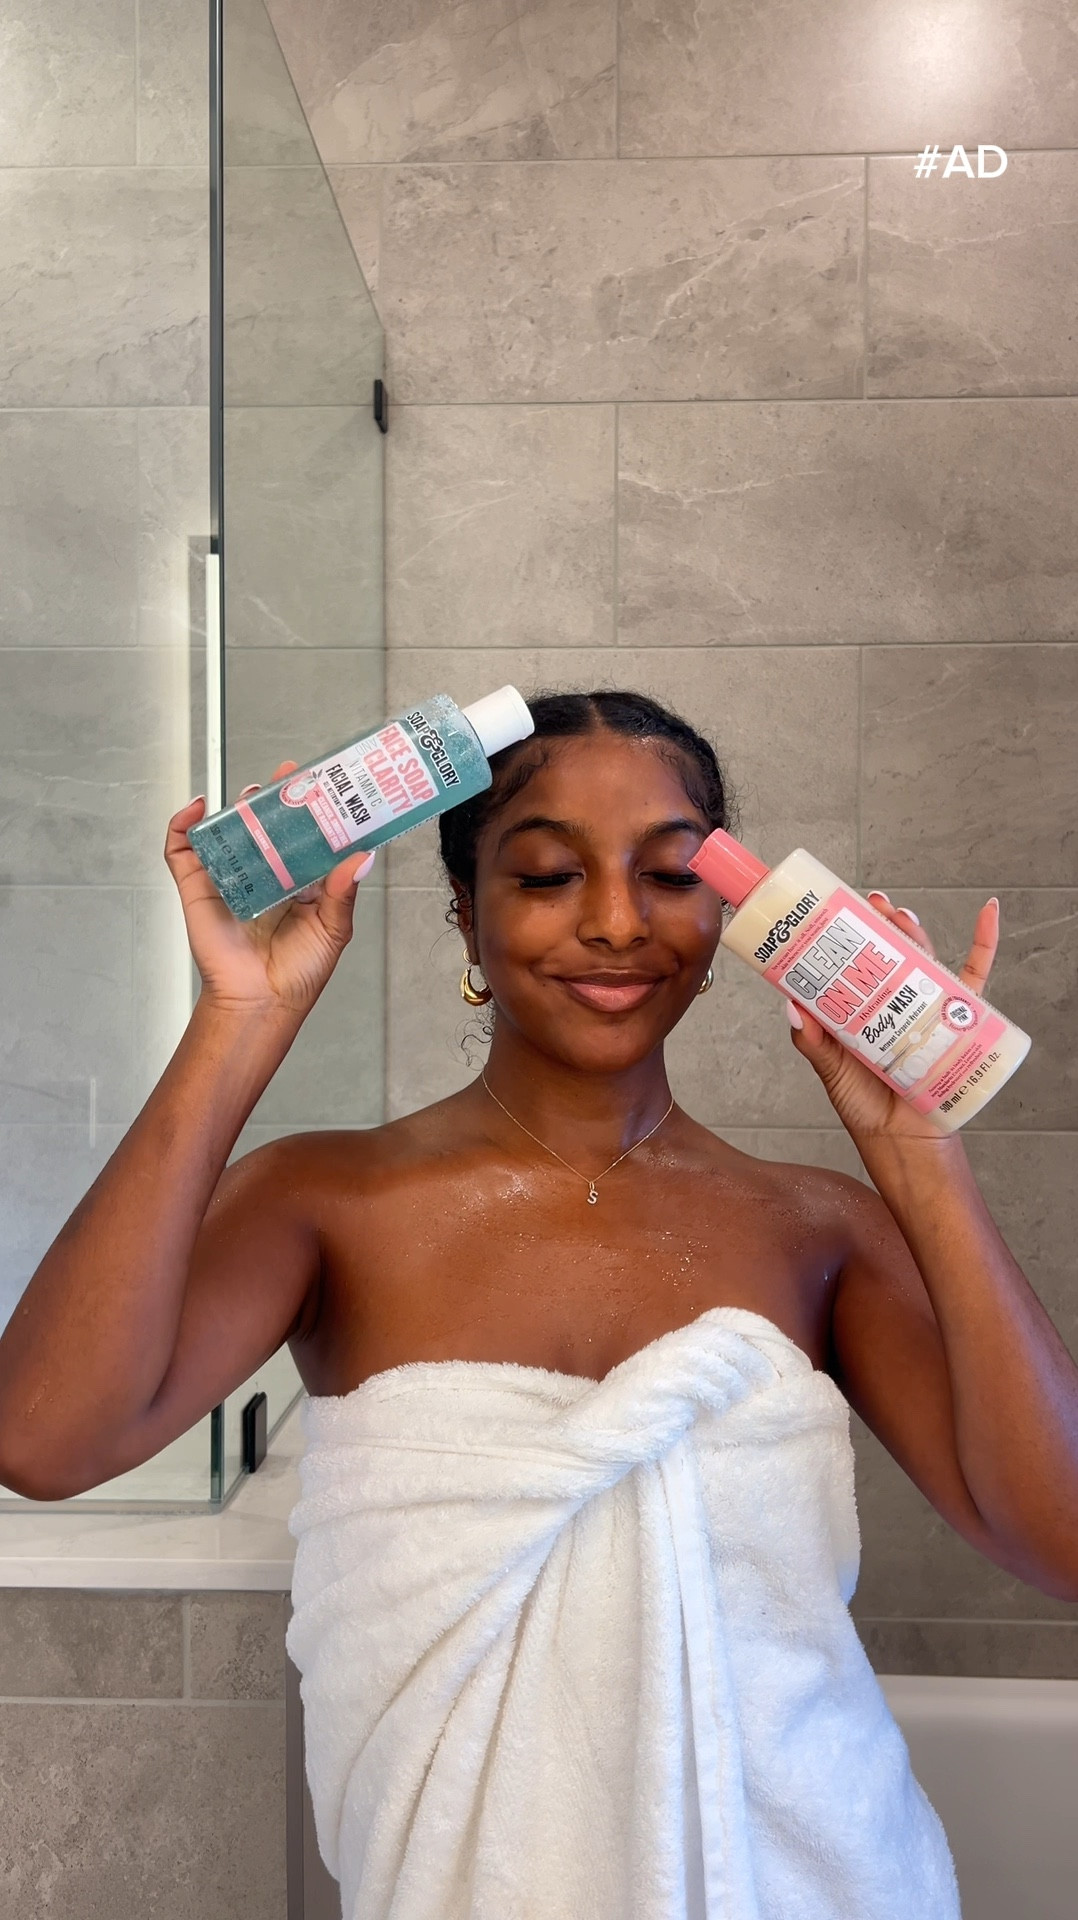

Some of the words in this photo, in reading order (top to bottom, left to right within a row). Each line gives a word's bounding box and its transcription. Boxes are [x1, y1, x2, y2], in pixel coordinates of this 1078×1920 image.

[348, 760, 377, 798] VITAMIN
[369, 797, 382, 807] C
[362, 747, 413, 813] CLARITY
[376, 725, 411, 761] FACE
[396, 756, 434, 801] SOAP
[325, 763, 354, 796] FACIAL
[344, 793, 371, 825] WASH
[227, 854, 243, 873] 11.8
[784, 915, 866, 1001] CLEAN
[813, 976, 863, 1027] ON
[859, 986, 891, 1020] Hydrating
[861, 1012, 894, 1044] Body
[887, 984, 918, 1014] WASH
[949, 1005, 967, 1018] ORIGINAL
[957, 1012, 968, 1023] PINK
[878, 1034, 897, 1052] Nettoyant
[894, 1018, 911, 1036] Corporel
[939, 1099, 953, 1113] 500
[949, 1091, 961, 1104] ml
[966, 1068, 983, 1087] 16.9
